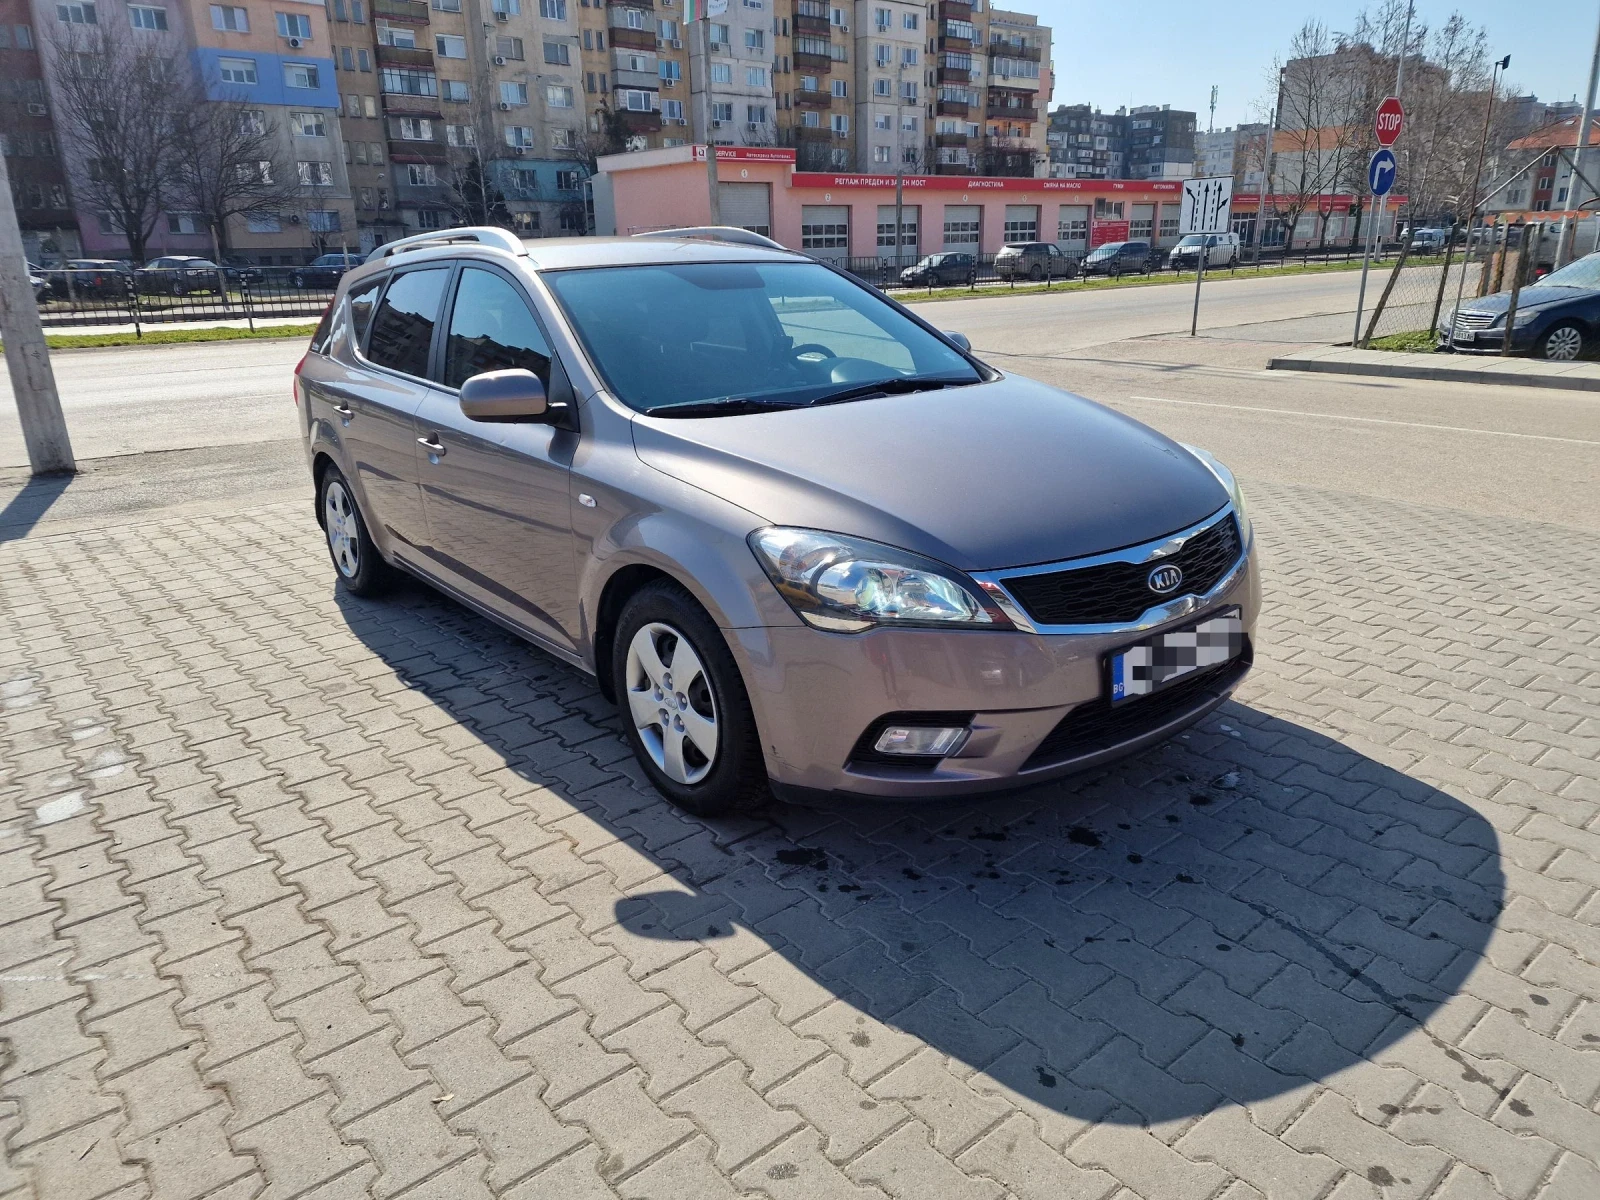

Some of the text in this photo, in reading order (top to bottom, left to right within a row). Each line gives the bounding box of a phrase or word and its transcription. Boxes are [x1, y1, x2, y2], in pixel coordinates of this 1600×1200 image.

[1378, 113, 1400, 130] STOP
[1153, 570, 1178, 588] KIA
[1114, 684, 1123, 694] BG
